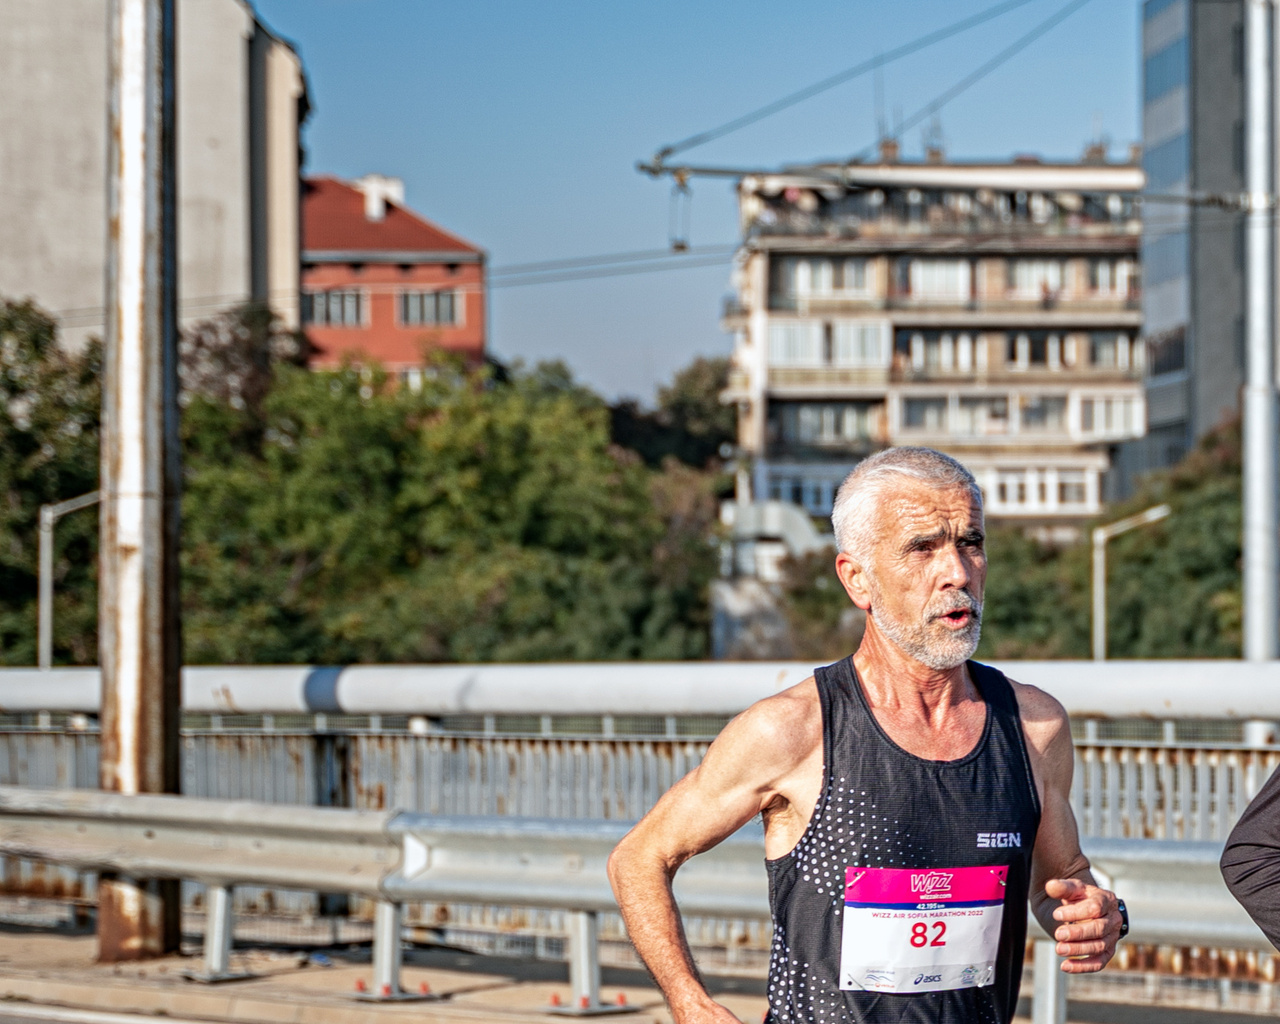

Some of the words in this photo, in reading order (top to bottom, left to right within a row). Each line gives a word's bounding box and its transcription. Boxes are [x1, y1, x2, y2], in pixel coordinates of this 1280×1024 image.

[907, 911, 928, 919] SOFIA
[929, 910, 967, 918] MARATHON
[967, 909, 984, 917] 2022
[910, 921, 947, 948] 82
